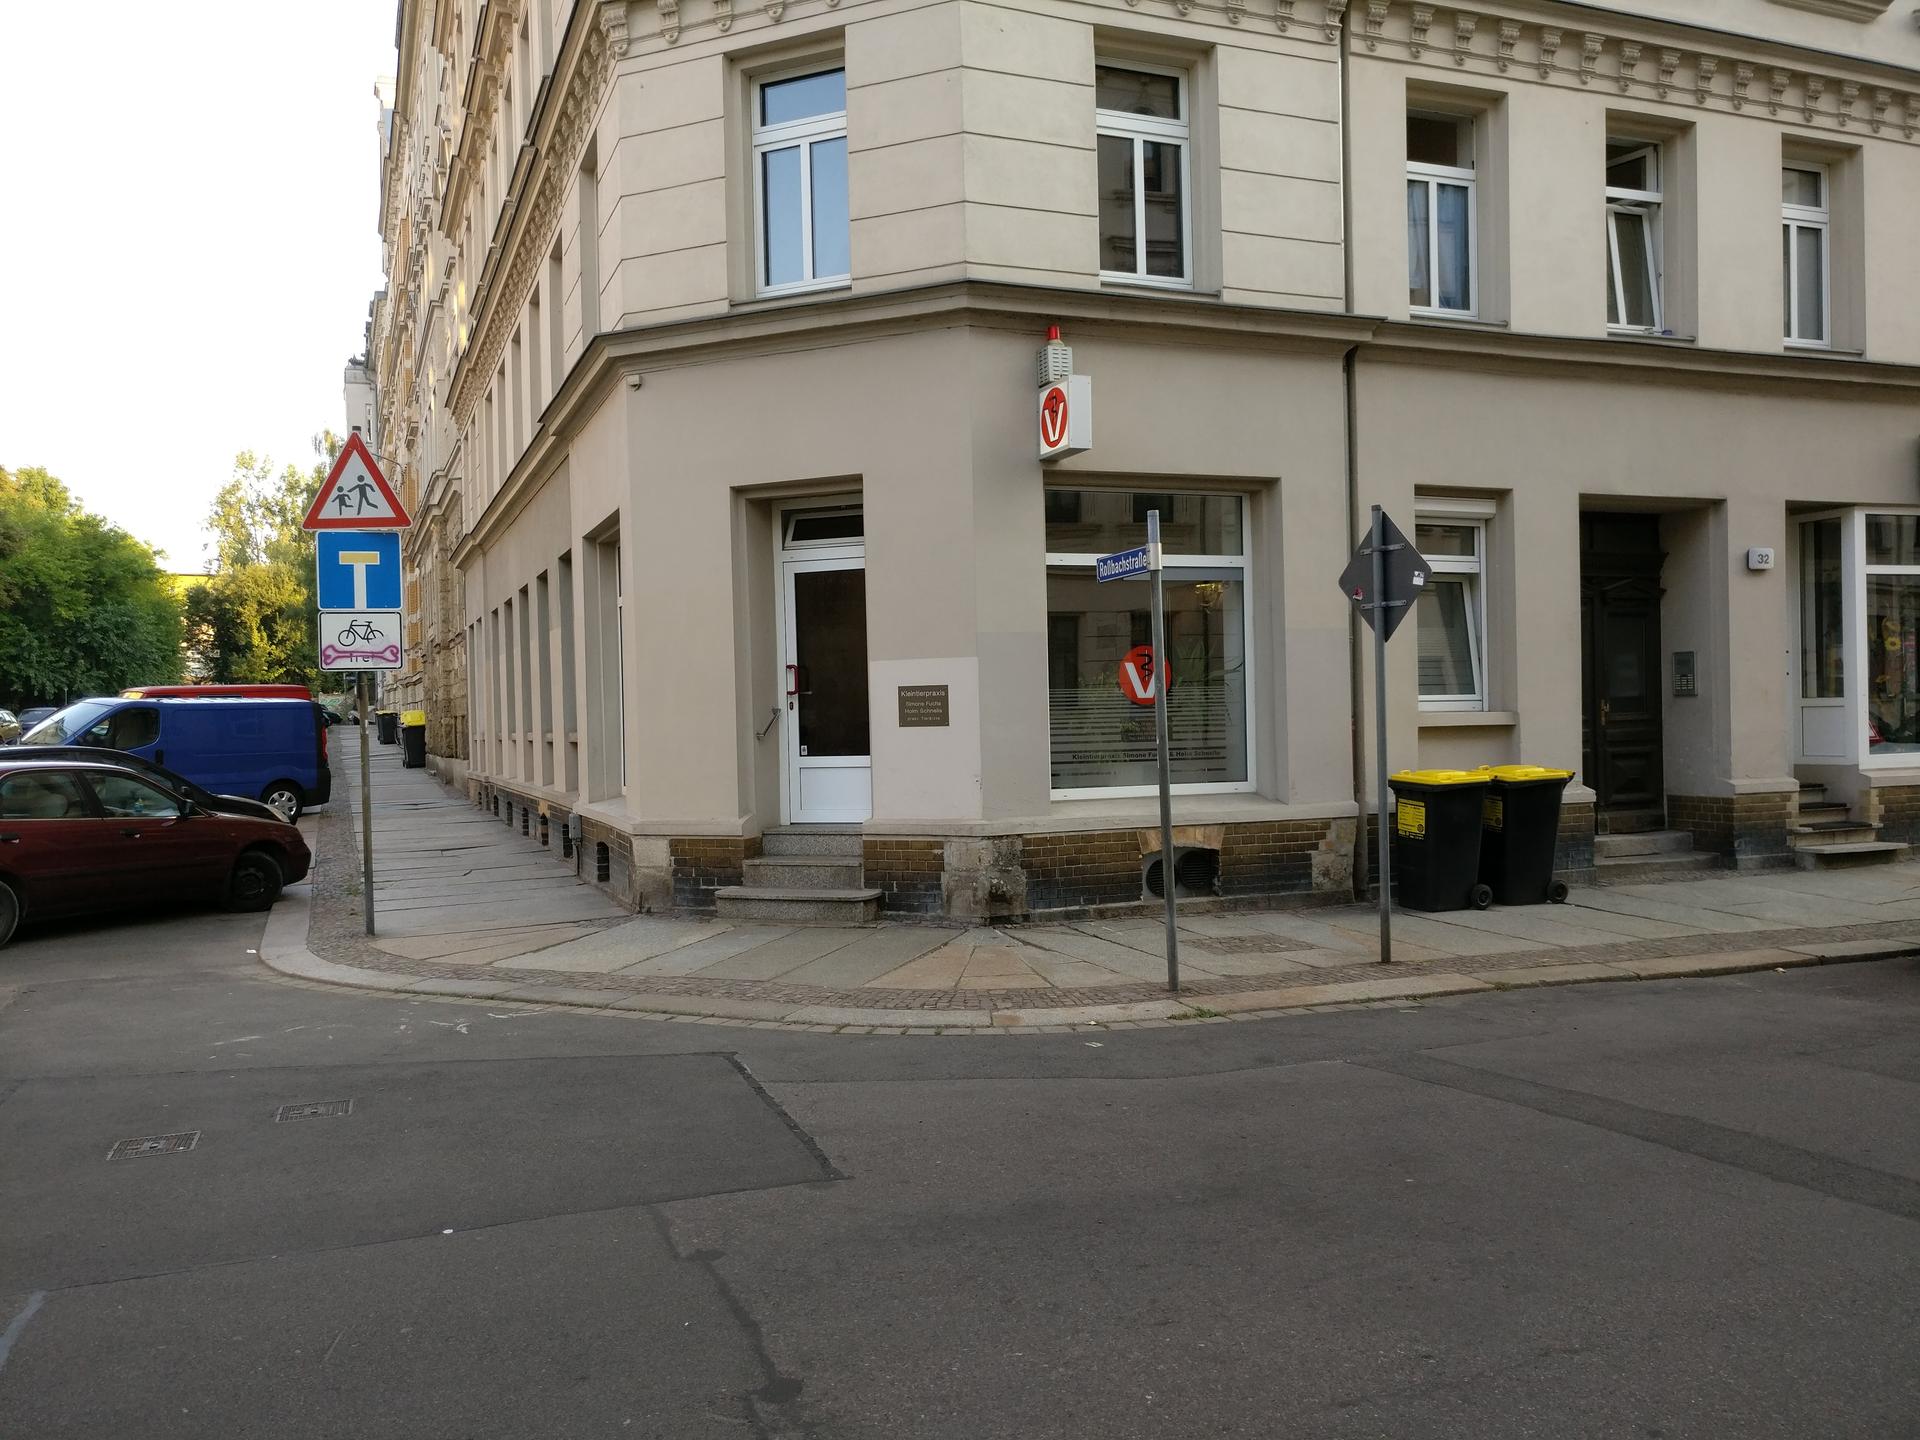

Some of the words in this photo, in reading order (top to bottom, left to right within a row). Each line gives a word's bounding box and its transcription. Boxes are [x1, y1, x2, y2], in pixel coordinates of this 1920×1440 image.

[1099, 552, 1147, 578] Roßbachstraße
[1757, 553, 1770, 565] 32
[901, 689, 946, 699] Kleintierpraxis
